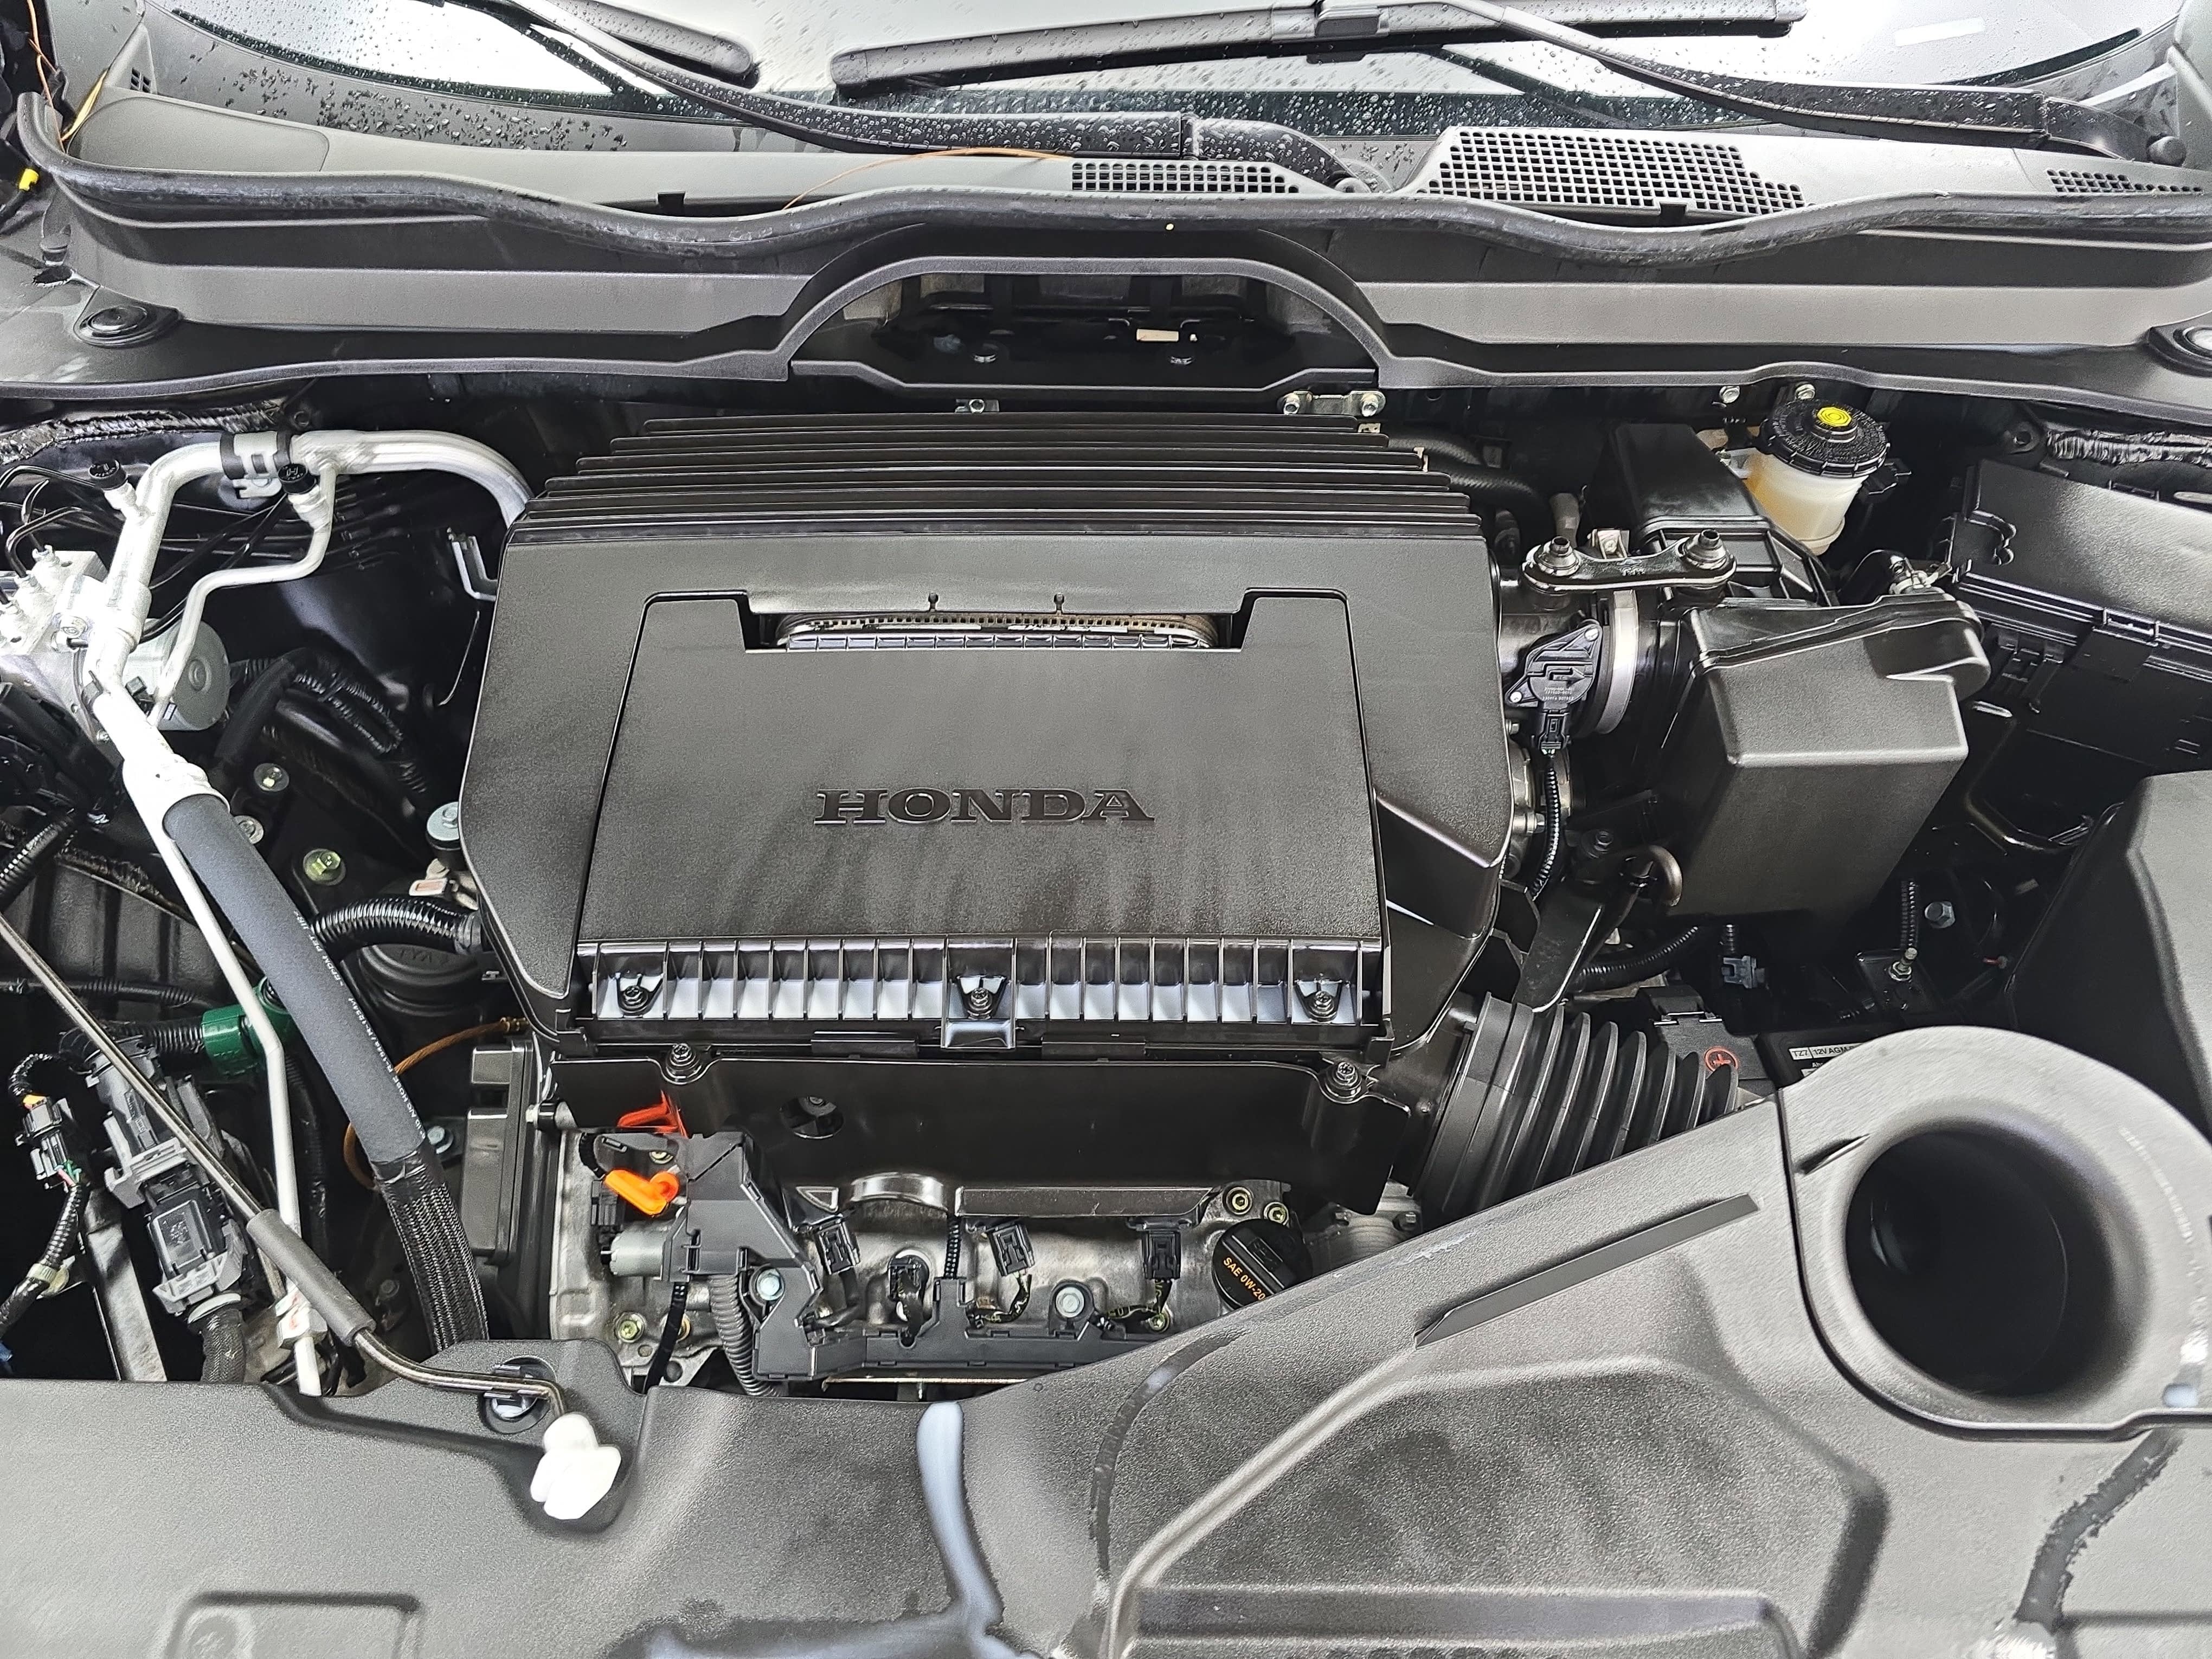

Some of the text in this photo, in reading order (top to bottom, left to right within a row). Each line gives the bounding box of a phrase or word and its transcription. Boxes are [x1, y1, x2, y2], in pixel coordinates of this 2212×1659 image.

[814, 788, 1155, 824] HONDA
[393, 1075, 408, 1102] HOSE
[1224, 1258, 1265, 1300] SAE 0W-20
